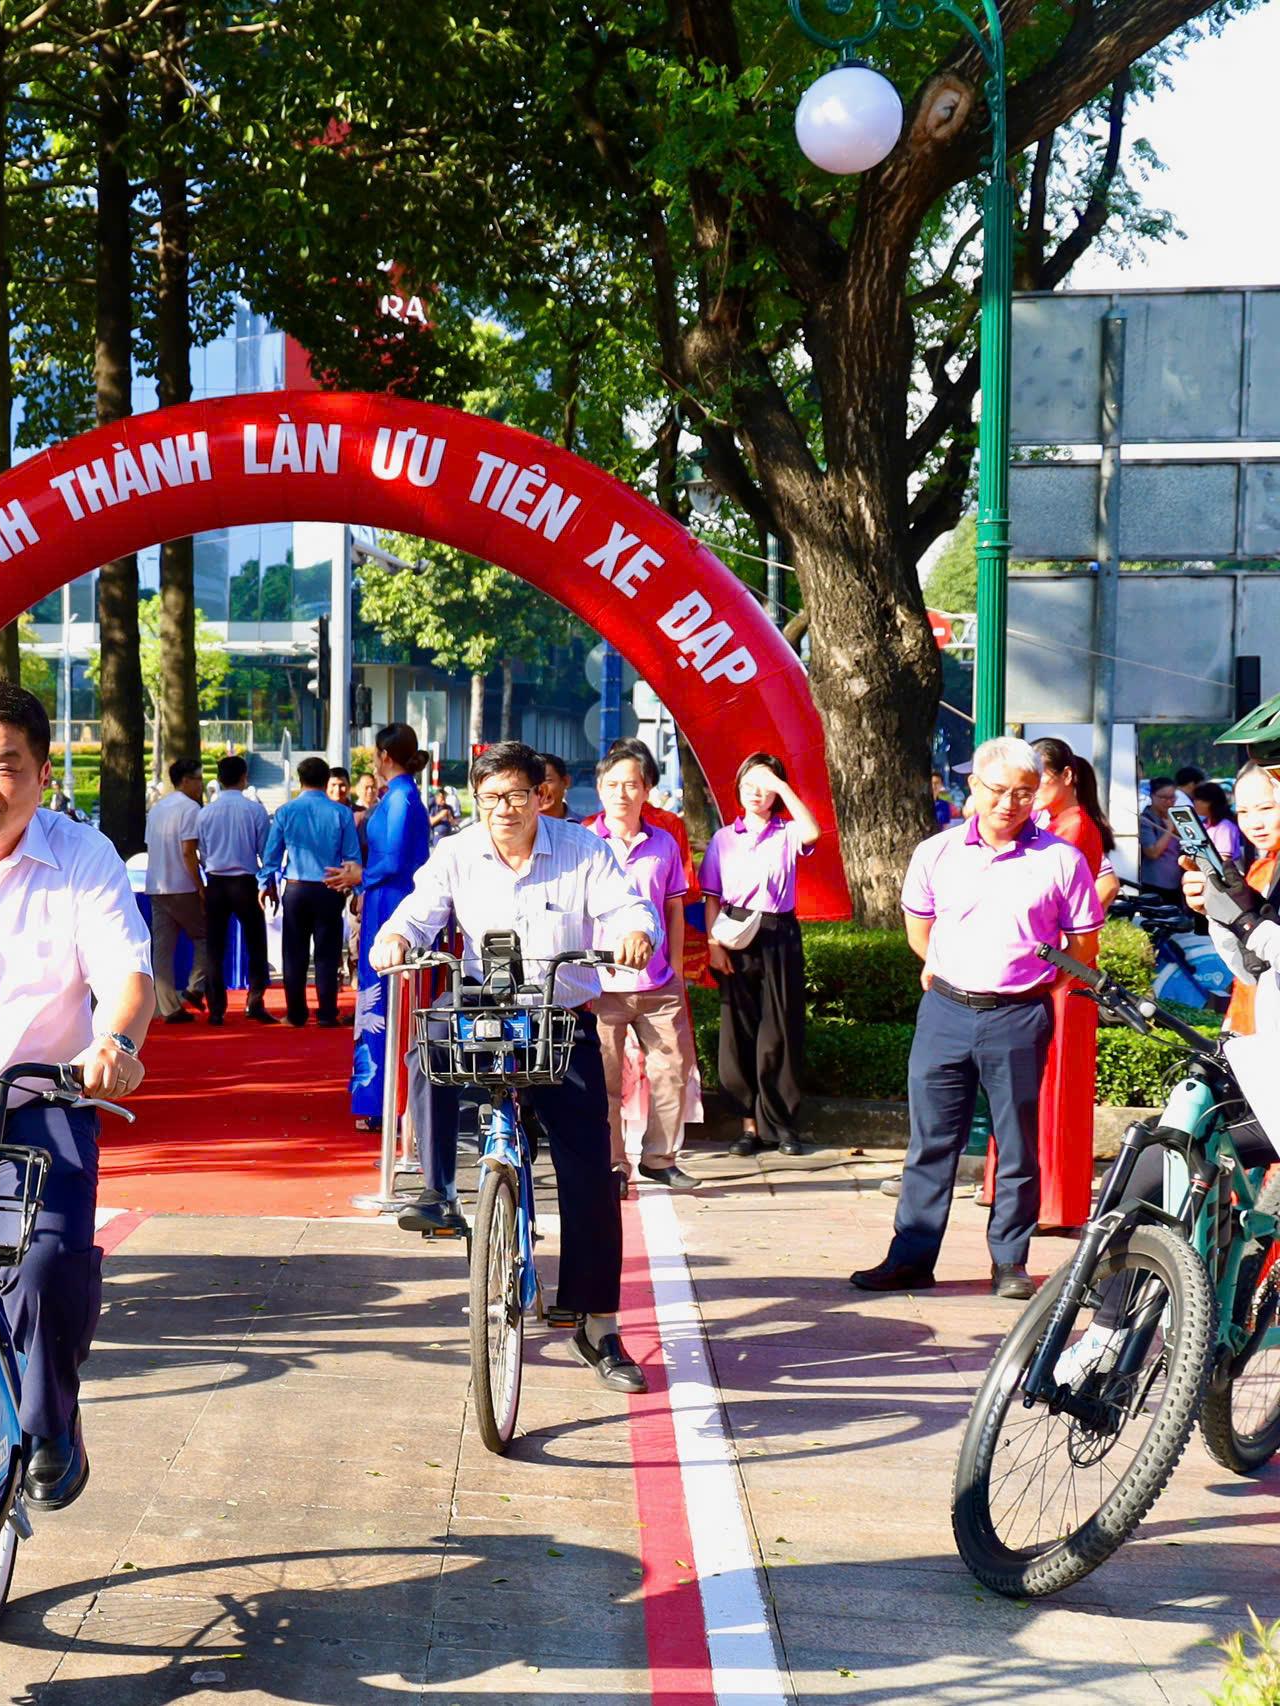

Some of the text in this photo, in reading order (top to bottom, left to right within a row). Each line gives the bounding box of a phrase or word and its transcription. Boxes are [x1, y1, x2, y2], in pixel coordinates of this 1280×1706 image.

[49, 431, 213, 522] THÀNH
[243, 414, 342, 474] LÀN
[370, 427, 447, 487] ƯU
[468, 450, 582, 543] TIÊN
[583, 520, 665, 599] XE
[656, 589, 758, 684] ĐẠP
